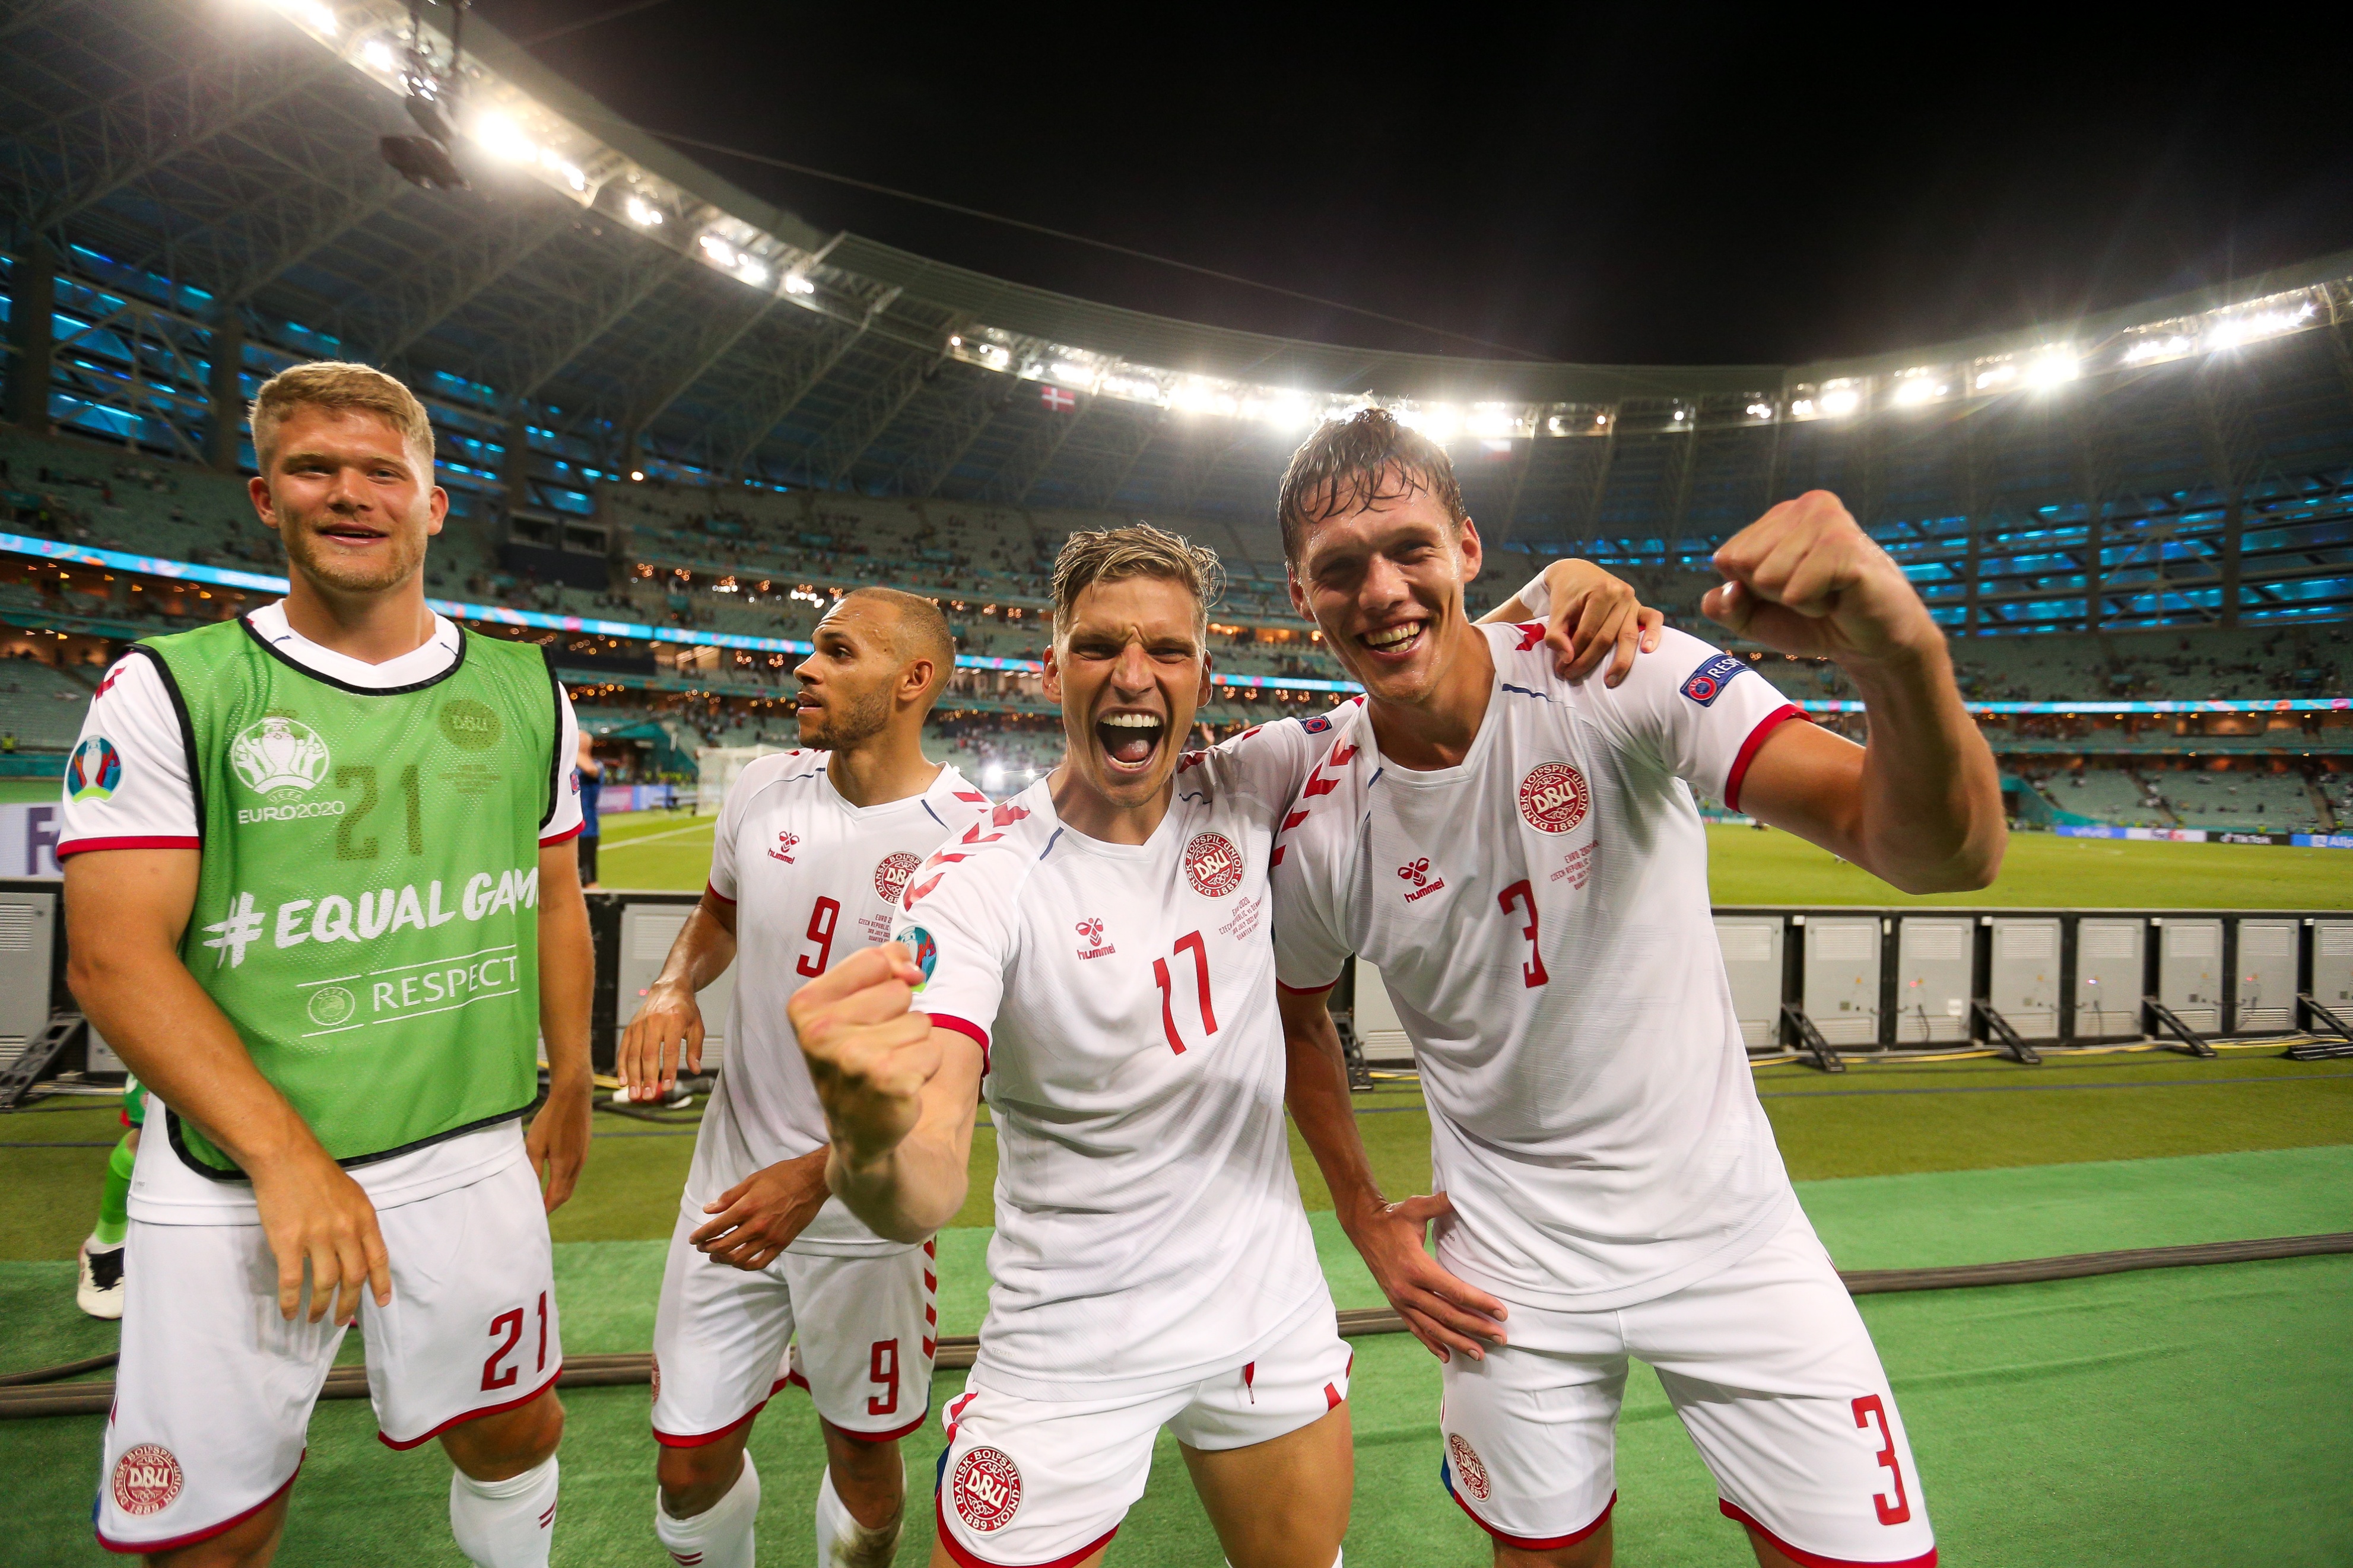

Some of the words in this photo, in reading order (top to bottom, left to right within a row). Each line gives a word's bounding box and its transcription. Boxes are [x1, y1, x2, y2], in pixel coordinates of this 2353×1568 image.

[238, 800, 345, 824] EURO2020
[269, 791, 302, 803] UEFA
[335, 764, 423, 861] 21
[1520, 795, 1548, 830] DANSK
[1554, 815, 1580, 832] 1889
[1531, 781, 1577, 814] DBU
[767, 847, 795, 864] hummel
[1193, 849, 1231, 881] DBU
[875, 862, 888, 893] DANSK
[884, 893, 900, 904] 188
[884, 867, 912, 885] DB
[1186, 864, 1212, 896] DANSK
[1216, 878, 1239, 896] 1889
[1404, 877, 1444, 903] hummel
[202, 880, 456, 969] #EQUAL
[462, 866, 538, 921] GAM
[1239, 896, 1250, 909] 2020
[796, 896, 840, 978] 9
[1498, 879, 1549, 988] 3
[1077, 943, 1116, 960] hummel
[374, 955, 517, 1012] RESPECT
[1152, 930, 1218, 1055] 17
[481, 1290, 547, 1392] 21
[868, 1338, 899, 1416] 9
[1457, 1449, 1482, 1480] DBU
[1851, 1394, 1910, 1525] 3
[128, 1465, 170, 1488] DBU
[954, 1459, 972, 1505] DANSK
[965, 1467, 1009, 1509] DBU
[1468, 1481, 1482, 1497] 1889
[961, 1509, 987, 1530] 1889
